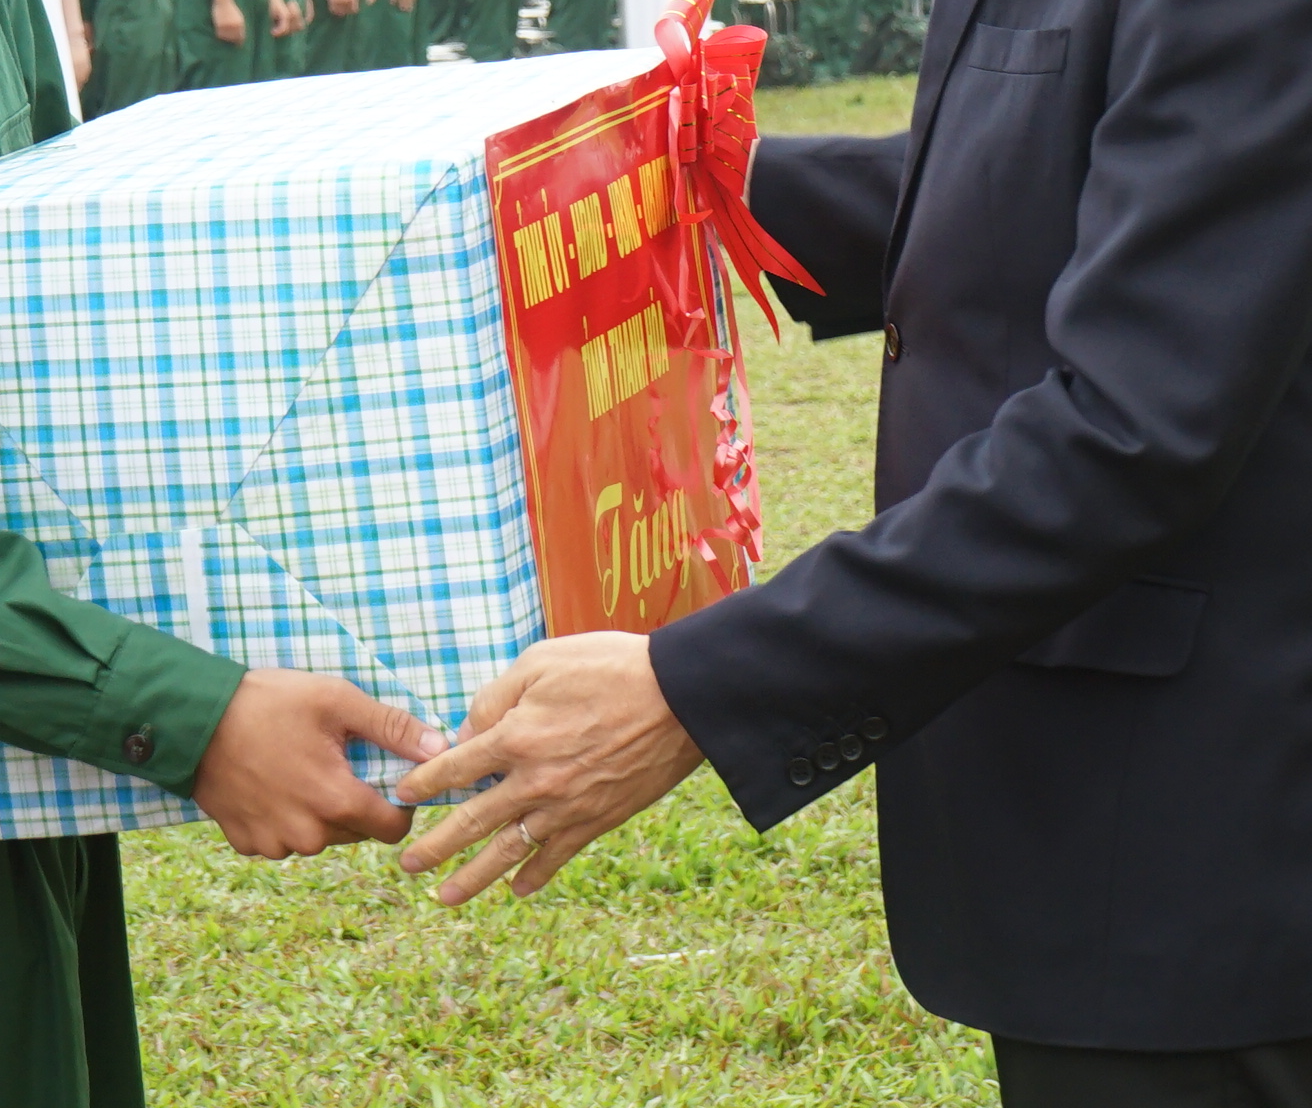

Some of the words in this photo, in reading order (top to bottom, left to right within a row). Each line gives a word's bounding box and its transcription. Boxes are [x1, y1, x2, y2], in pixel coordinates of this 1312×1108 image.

[513, 199, 554, 309] TỈNH
[541, 188, 570, 294] ỦY
[569, 192, 608, 280] HĐND
[607, 174, 642, 259] UBND
[581, 315, 613, 422] TỈNH
[607, 312, 649, 405] THANH
[643, 286, 669, 382] HÒA
[595, 482, 691, 619] Tặng
